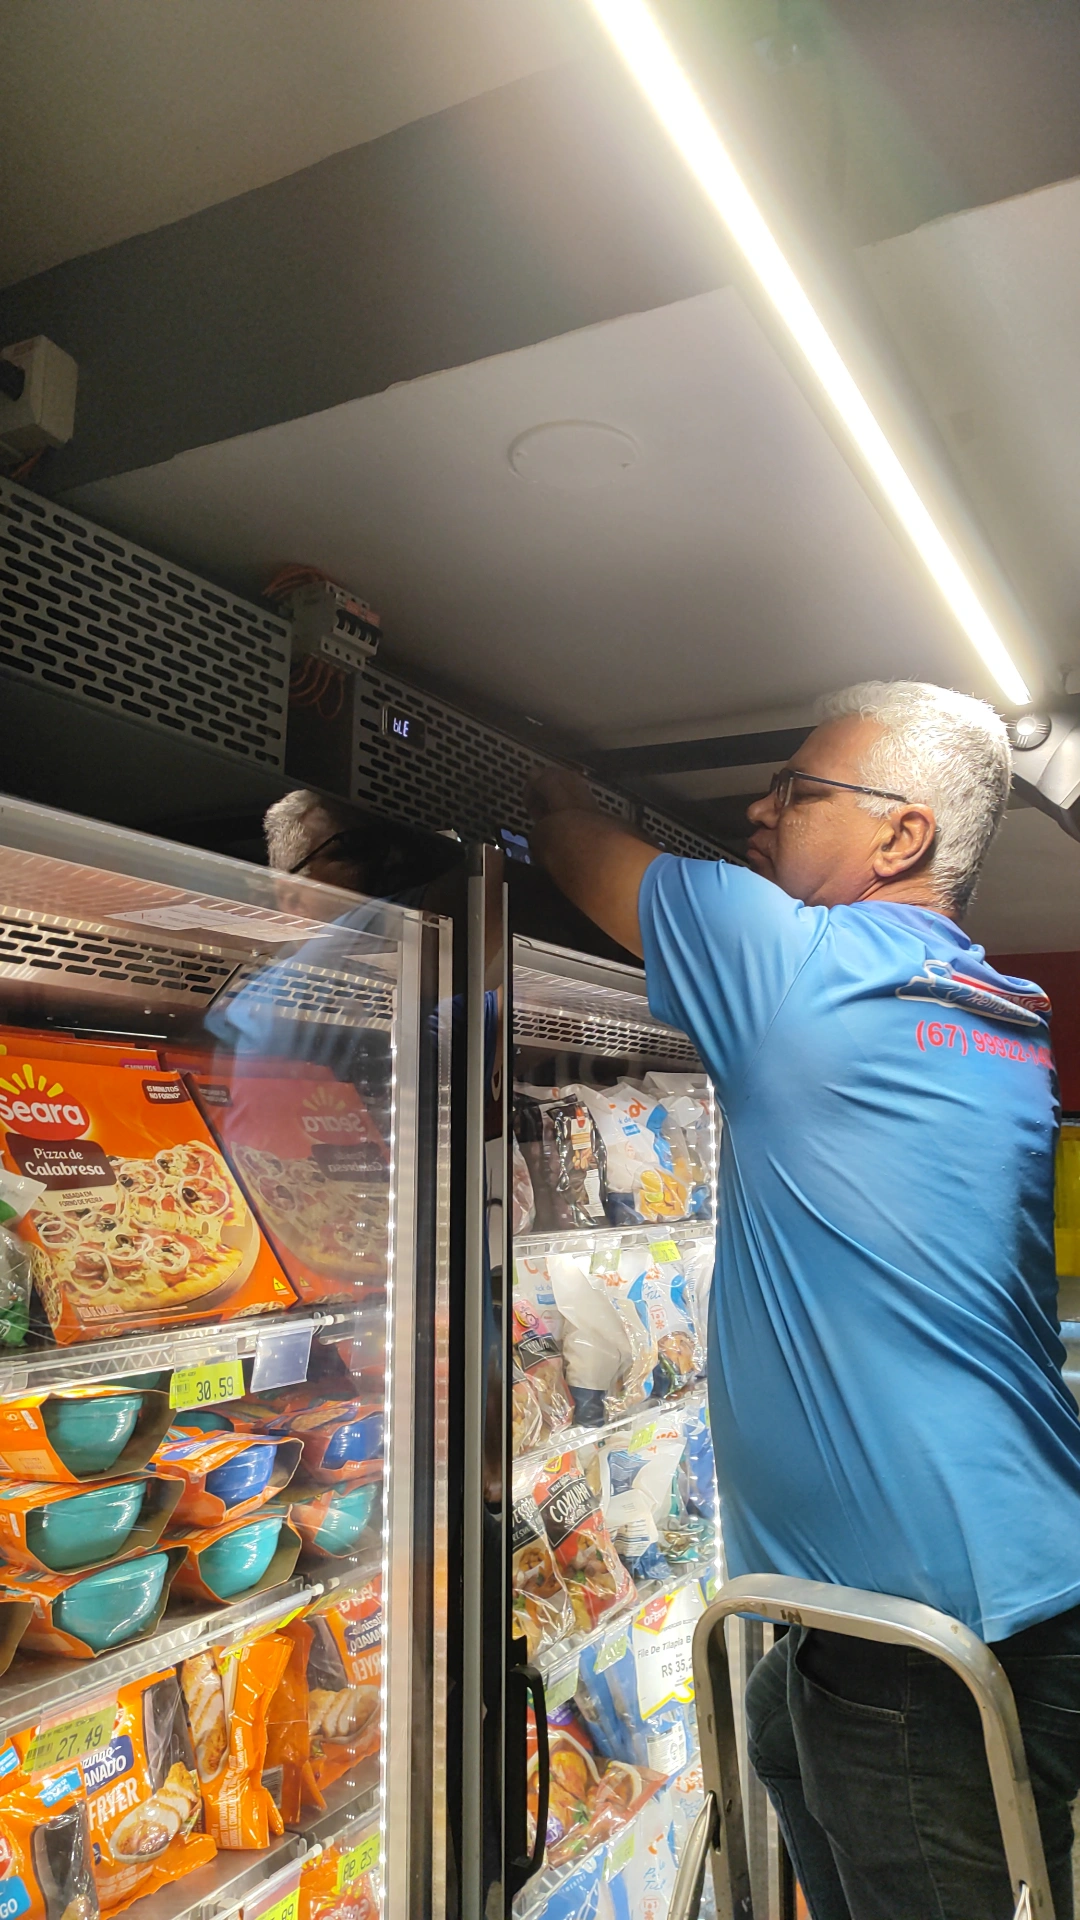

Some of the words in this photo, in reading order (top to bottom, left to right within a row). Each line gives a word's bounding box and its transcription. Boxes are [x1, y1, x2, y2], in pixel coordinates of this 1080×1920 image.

[915, 1020, 968, 1056] (67)
[149, 1092, 158, 1100] NO
[152, 1085, 180, 1093] MINUTOS
[0, 1094, 86, 1126] Seara
[33, 1148, 68, 1160] Pizza
[69, 1148, 84, 1160] de
[24, 1161, 106, 1176] Calabresa
[59, 1199, 78, 1207] FORNO
[77, 1198, 85, 1206] DE
[85, 1196, 104, 1205] PEDRA
[62, 1192, 84, 1200] ASSADA
[84, 1190, 93, 1198] EM
[650, 1645, 661, 1655] De
[662, 1637, 684, 1652] Tilapia
[661, 1662, 673, 1678] R$
[87, 1777, 141, 1832] FRYER
